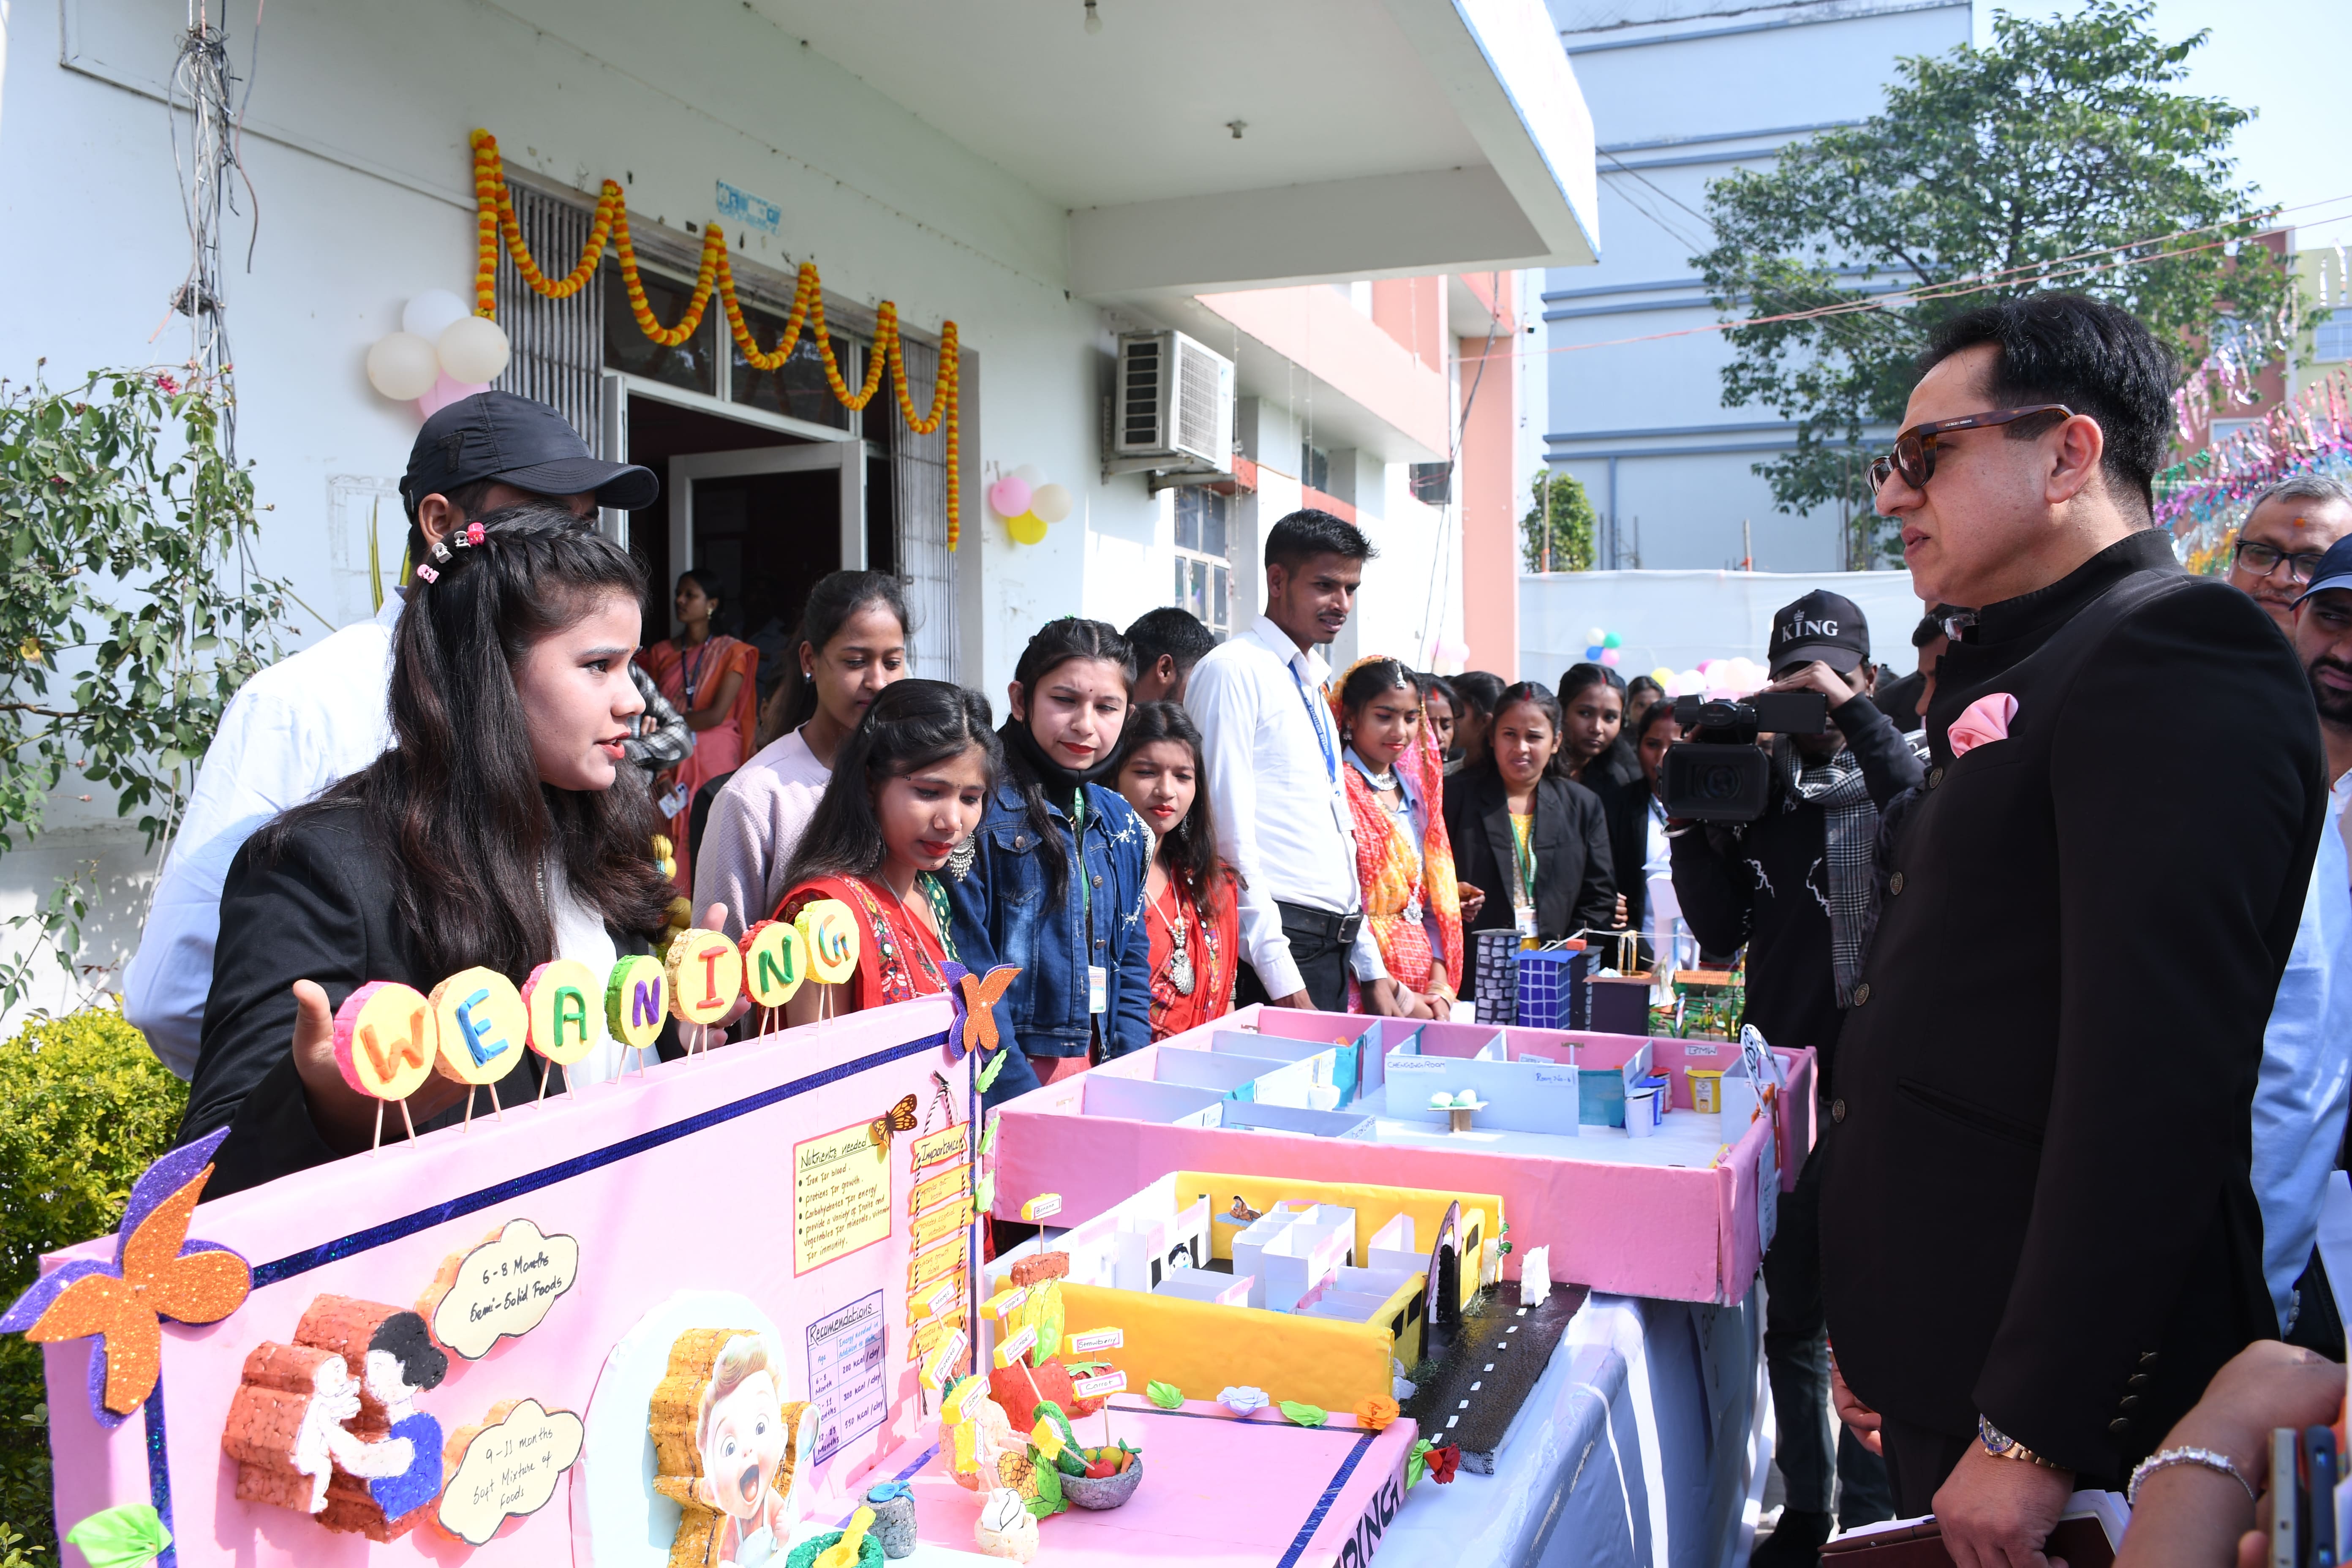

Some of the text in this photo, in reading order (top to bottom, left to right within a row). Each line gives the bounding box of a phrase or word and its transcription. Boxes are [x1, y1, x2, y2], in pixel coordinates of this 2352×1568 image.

[1781, 619, 1839, 643] KING
[360, 915, 850, 1084] WEANING
[1686, 1046, 1717, 1055] BMW
[800, 1132, 868, 1168] Nutrients needed
[921, 1138, 959, 1165] Importance
[806, 1174, 818, 1186] Iron
[858, 1184, 877, 1199] energy
[833, 1209, 850, 1222] variety
[876, 1194, 884, 1205] and
[1036, 1203, 1054, 1214] Banana
[804, 1229, 833, 1249] vegetables
[513, 1252, 549, 1276] Months
[533, 1277, 563, 1298] Foods
[1005, 1296, 1019, 1310] Apple
[810, 1303, 872, 1346] Recomendations
[1078, 1337, 1116, 1348] Strawberry
[843, 1363, 851, 1374] 200
[1086, 1380, 1113, 1390] Carrot
[844, 1391, 852, 1401] 300
[821, 1407, 836, 1421] onths
[845, 1418, 854, 1429] 550
[518, 1428, 553, 1450] months
[501, 1462, 536, 1487] Mixture
